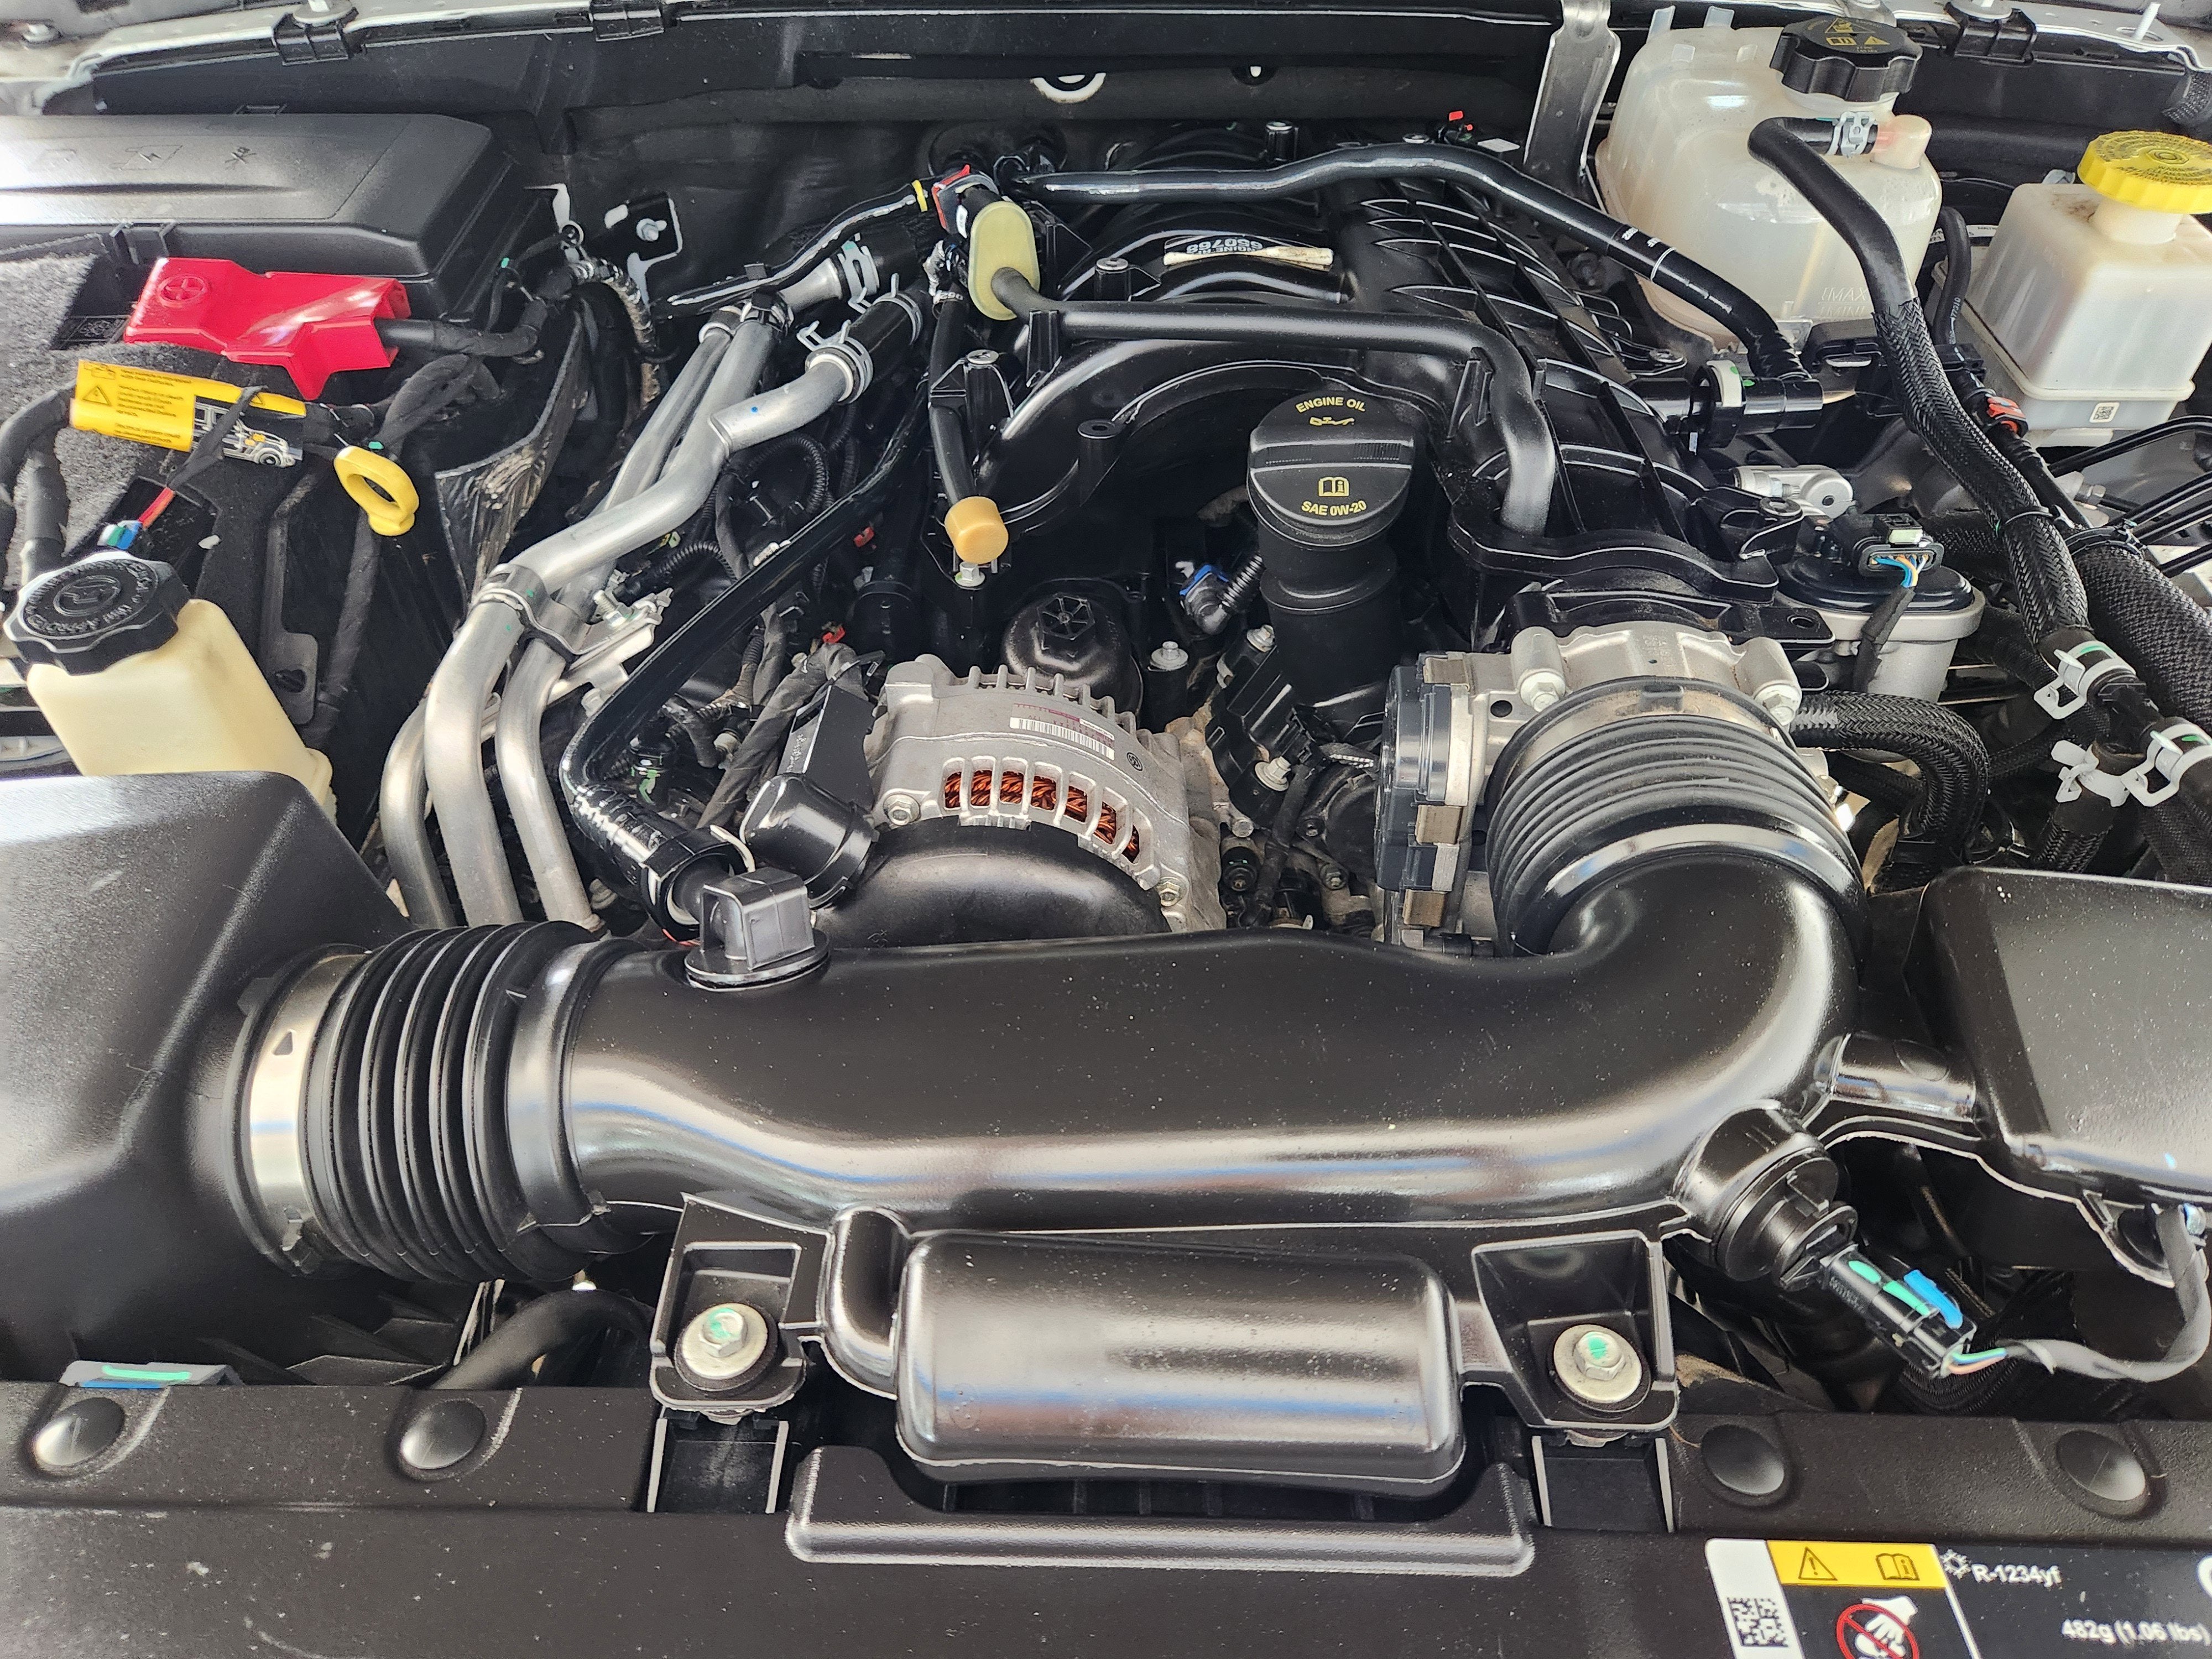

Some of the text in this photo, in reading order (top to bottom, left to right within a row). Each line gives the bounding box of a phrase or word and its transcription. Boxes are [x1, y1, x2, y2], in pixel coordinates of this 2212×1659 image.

[1295, 397, 1366, 413] ENGINE OIL
[1301, 500, 1367, 517] SAE 0W-20
[1970, 1564, 2062, 1588] R-1234yf
[2061, 1619, 2116, 1645] 482g
